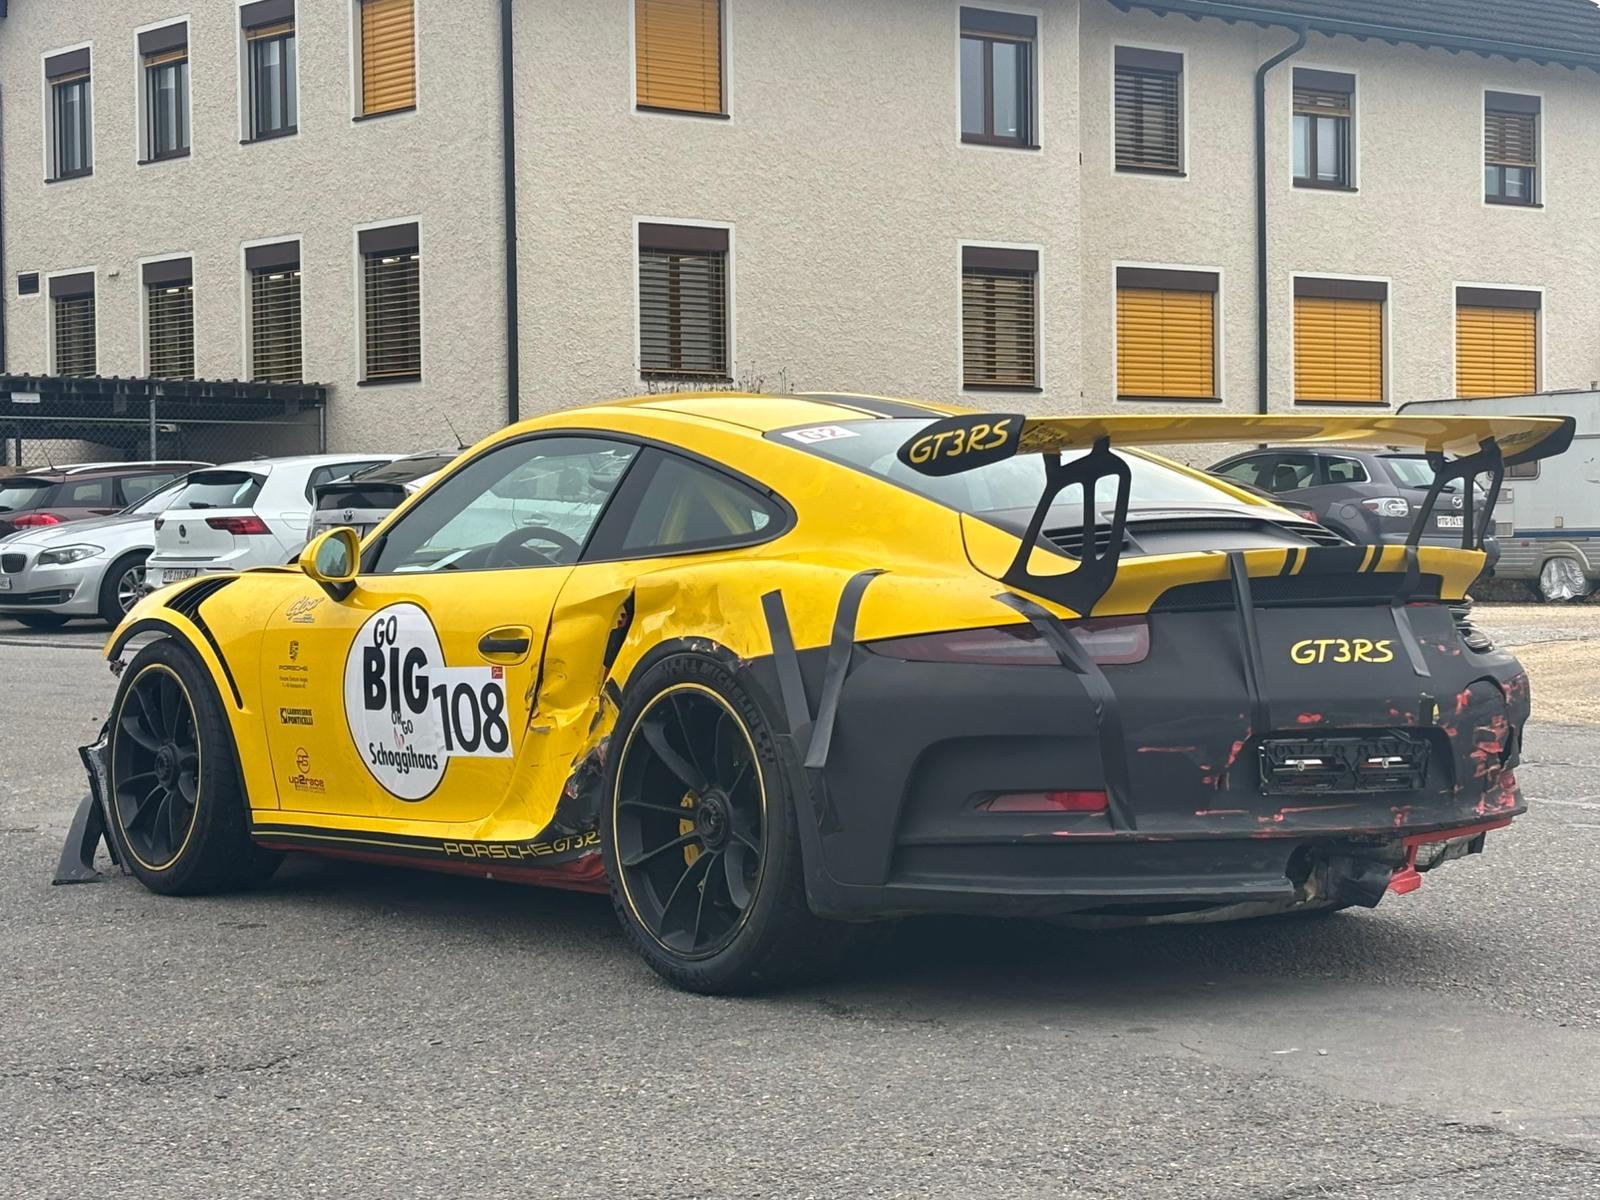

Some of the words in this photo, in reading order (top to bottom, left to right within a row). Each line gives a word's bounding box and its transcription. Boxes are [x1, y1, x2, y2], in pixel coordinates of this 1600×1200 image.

[796, 425, 846, 440] G2
[909, 418, 1012, 464] GT3RS
[373, 615, 397, 648] GO
[1290, 638, 1395, 664] GT3RS
[363, 646, 429, 714] BIG
[699, 661, 761, 729] MICHELIN
[401, 719, 414, 735] GO
[432, 682, 509, 754] 108
[369, 741, 438, 774] Schoggihaas
[443, 842, 554, 860] PORSCHE
[553, 831, 601, 853] GT3R
